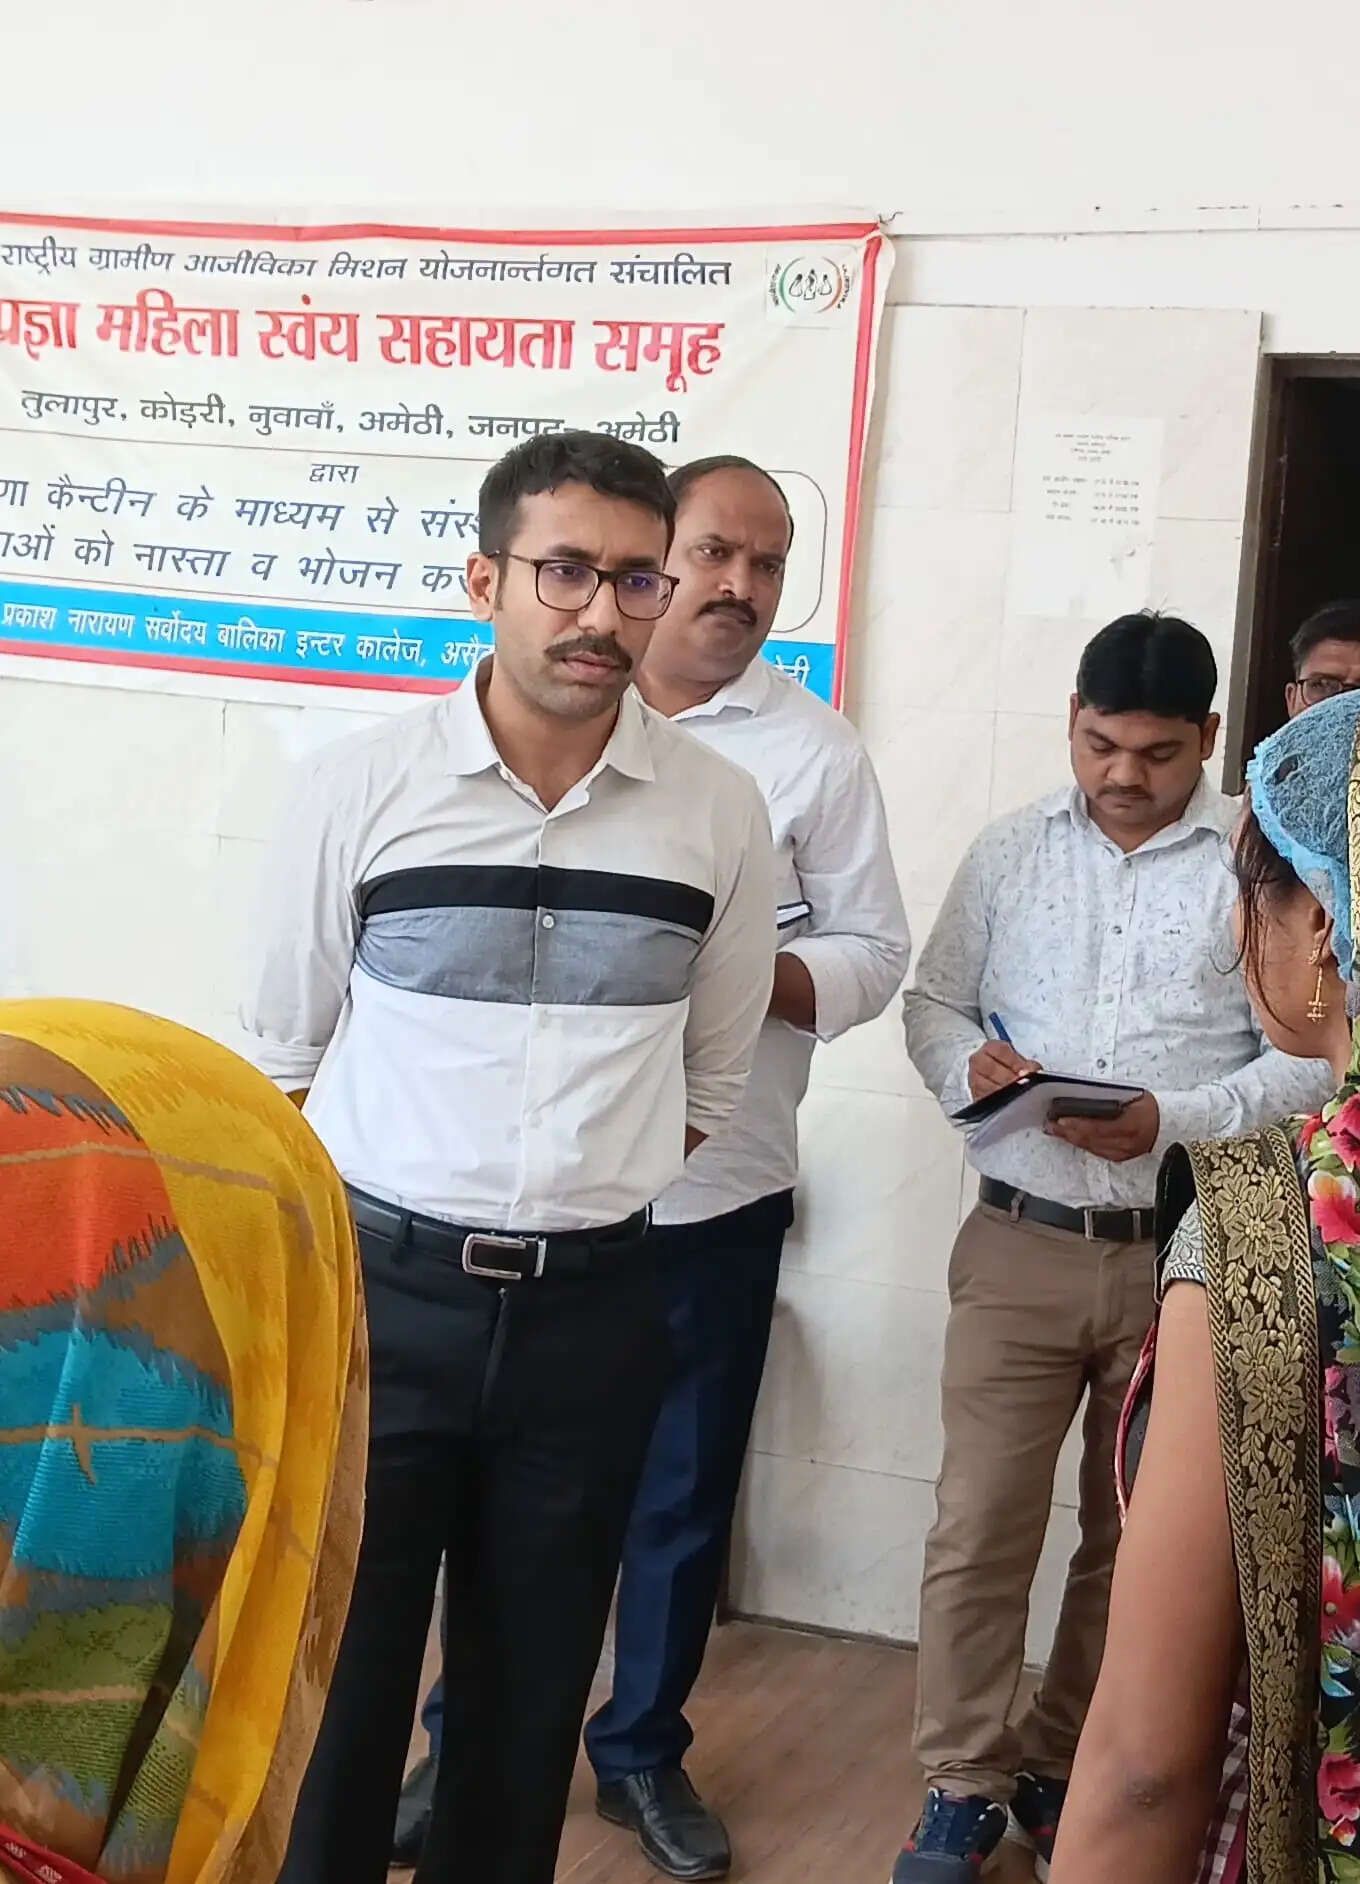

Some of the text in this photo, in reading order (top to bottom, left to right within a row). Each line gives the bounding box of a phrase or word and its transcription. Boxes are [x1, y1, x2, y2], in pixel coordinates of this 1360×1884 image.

[1, 236, 77, 275] राष्ट्रीय
[89, 243, 176, 270] ग्रामीण
[184, 249, 318, 276] आजीविका
[328, 251, 408, 279] मिशन
[610, 253, 732, 285] संचालित
[96, 288, 240, 357] महिला
[376, 314, 576, 369] सहायता
[592, 320, 725, 392] समूह
[21, 389, 127, 425] तुलापुर,
[359, 402, 453, 439] अमेठी,
[309, 464, 360, 483] द्वारा
[48, 474, 157, 517] कैन्टीन
[177, 485, 214, 521] के
[235, 499, 345, 531] माध्यम
[367, 496, 399, 534] से
[74, 529, 115, 566] को
[133, 544, 231, 576] नास्ता
[251, 554, 278, 581] व
[299, 547, 402, 590] भोजन
[3, 604, 57, 629] प्रकाश
[68, 610, 135, 636] नारायण
[146, 611, 207, 644] सर्वोदय
[218, 617, 285, 651] बालिका
[297, 632, 345, 657] इन्टर
[357, 629, 425, 666] कालेज,
